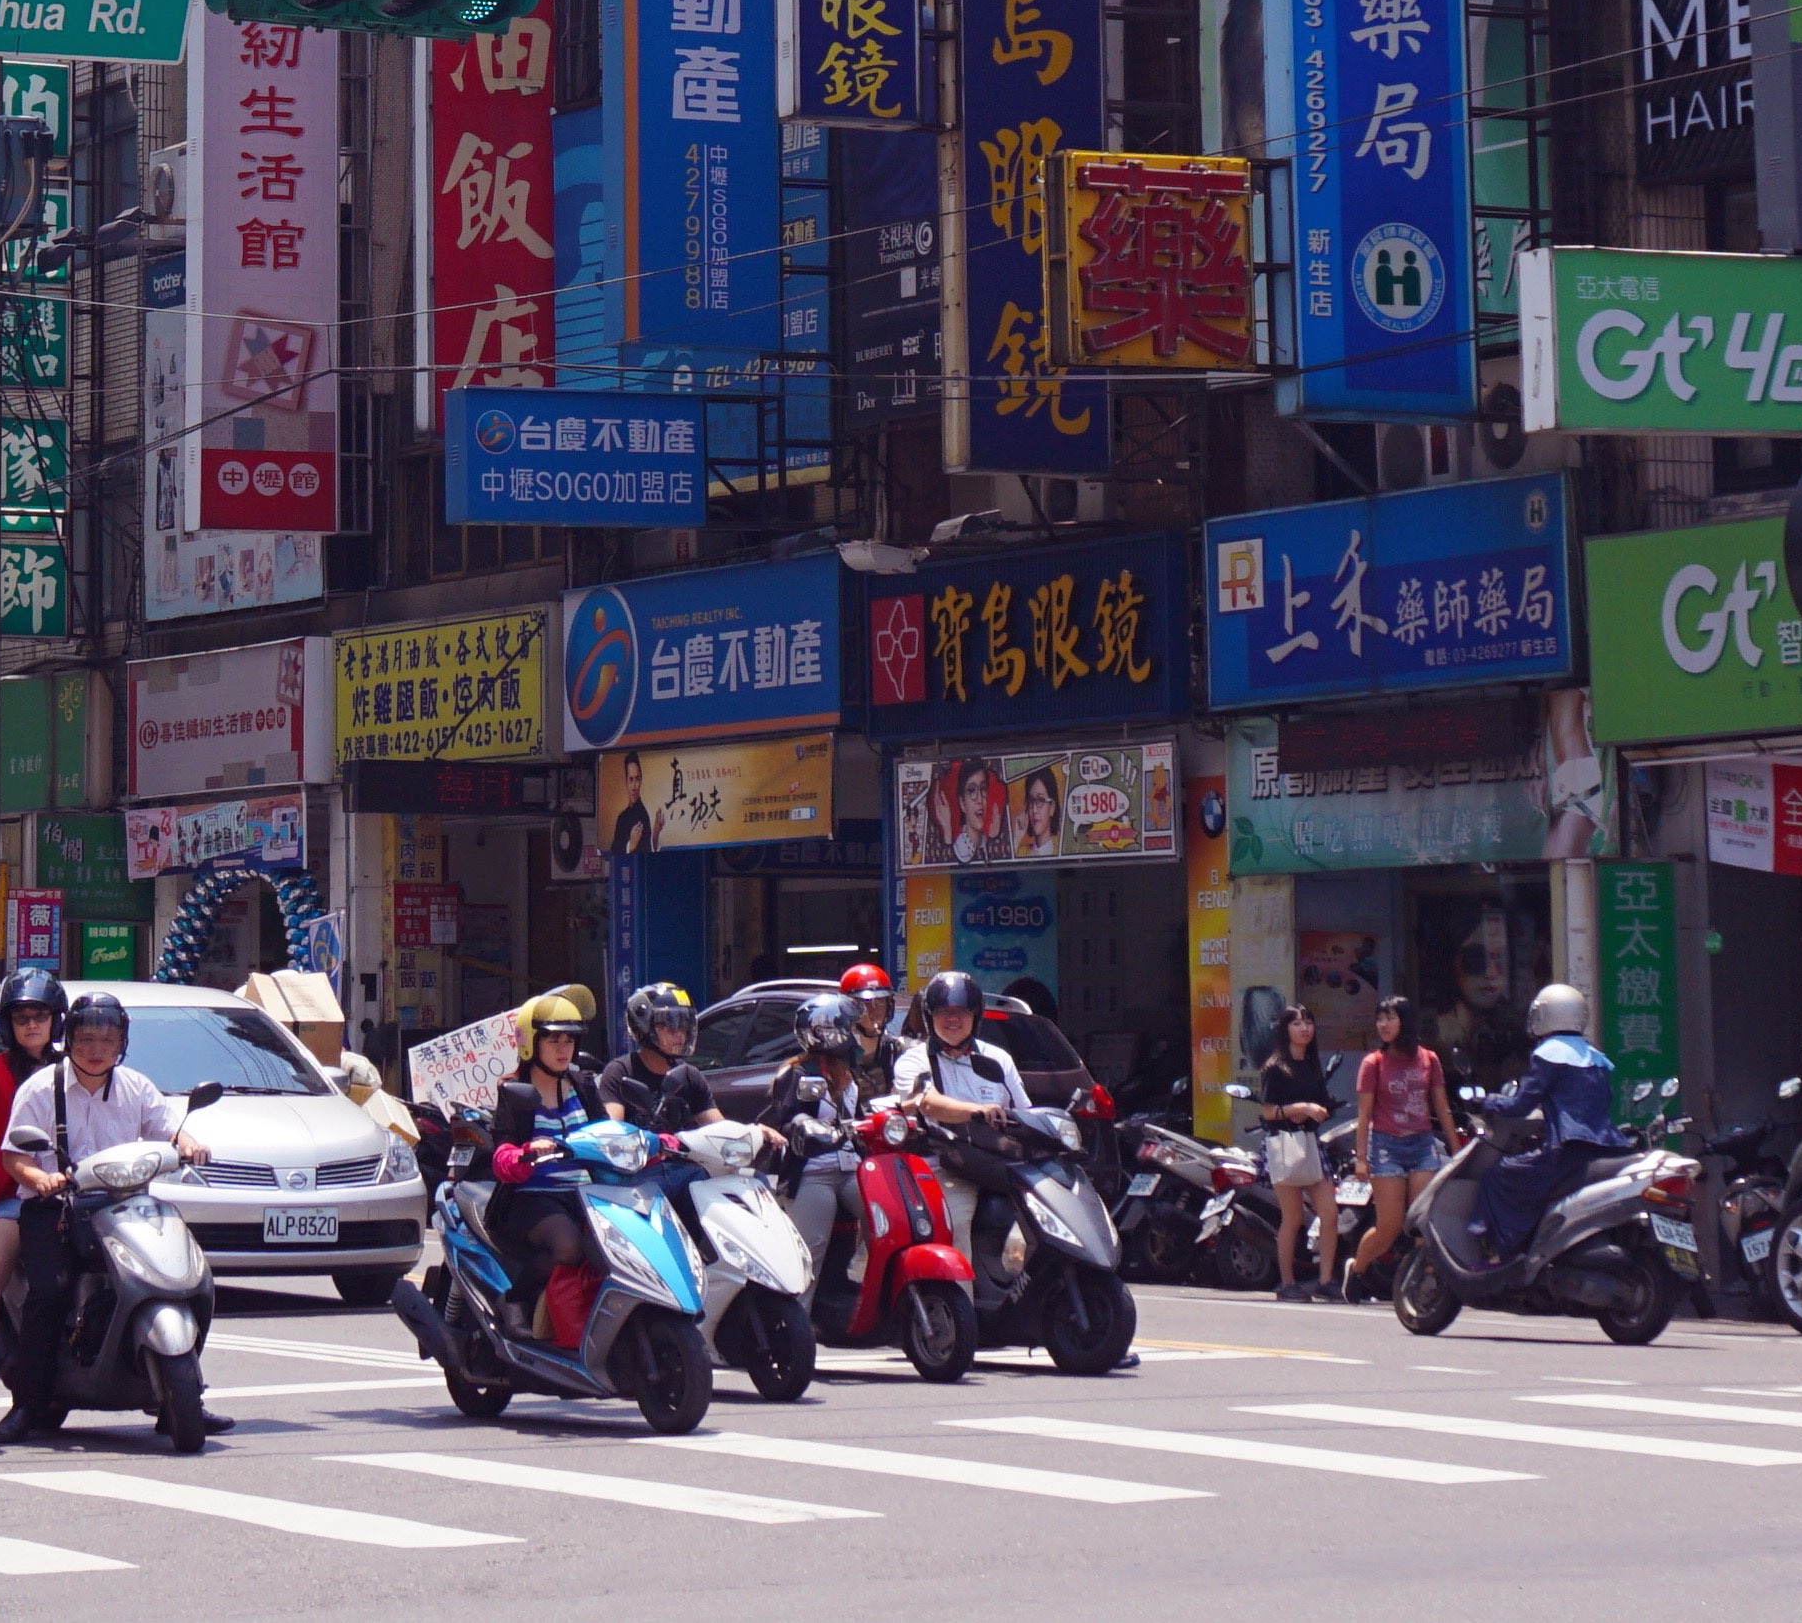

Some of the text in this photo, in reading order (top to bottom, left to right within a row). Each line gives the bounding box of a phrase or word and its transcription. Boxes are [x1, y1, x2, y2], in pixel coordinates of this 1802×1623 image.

[709, 143, 730, 310] 中壢SOGO加盟店
[1076, 157, 1253, 364] 藥
[1307, 227, 1333, 318] 新生店
[1576, 274, 1661, 301] 亞太電信
[518, 414, 697, 455] 台慶不動產
[221, 464, 319, 492] 中壢館
[480, 467, 694, 505] 中壢SOGO加盟店
[1265, 528, 1556, 667] 上禾藥師藥局
[930, 570, 1152, 703] 寶島眼鏡
[1520, 636, 1559, 659] 新生店
[650, 618, 823, 702] 台慶不動產
[1081, 790, 1118, 815] 1980
[914, 908, 945, 926] FENDI
[986, 904, 1044, 927] 1980
[1197, 889, 1229, 909] FEND
[29, 903, 52, 958] 薇爾
[1614, 871, 1663, 1056] 亞太繳費
[452, 1056, 506, 1090] 700
